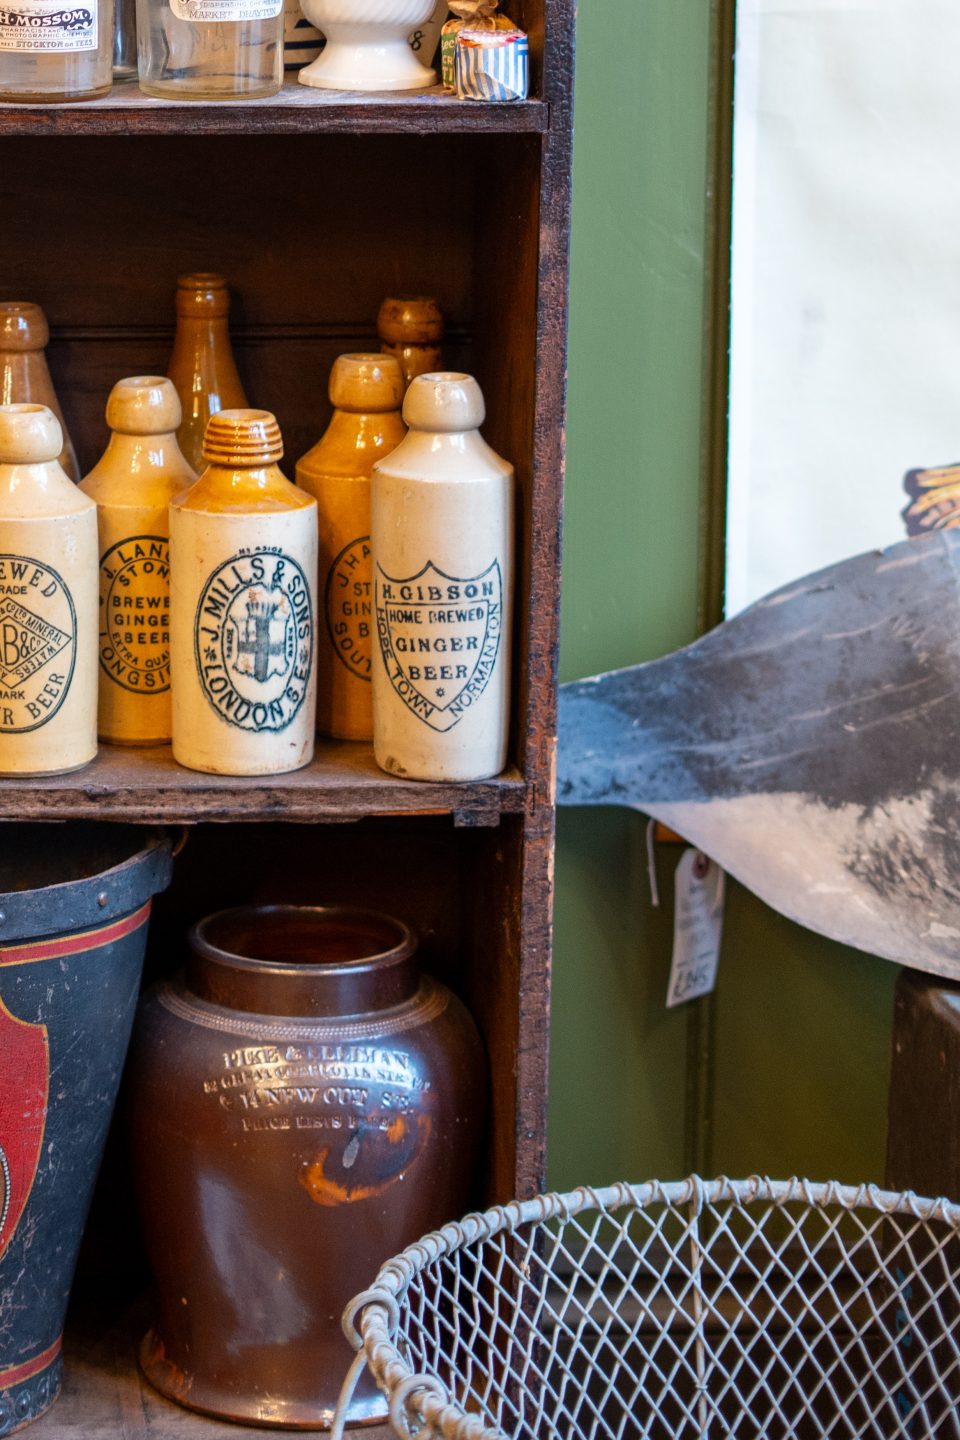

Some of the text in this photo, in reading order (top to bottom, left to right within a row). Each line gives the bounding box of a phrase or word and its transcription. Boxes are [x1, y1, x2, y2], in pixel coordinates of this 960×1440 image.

[204, 557, 265, 621] MILLS
[272, 560, 285, 583] &
[288, 575, 310, 640] SONS
[400, 582, 494, 601] GIBSON
[390, 607, 484, 624] HOME BREWED
[26, 617, 63, 646] MINERAL
[395, 636, 478, 653] GINGER
[112, 632, 138, 665] EXTRA
[377, 603, 500, 719] HOPE TOWN NORMANTON
[409, 665, 468, 680] BEER
[24, 672, 65, 719] BEER
[204, 665, 284, 725] LONDON
